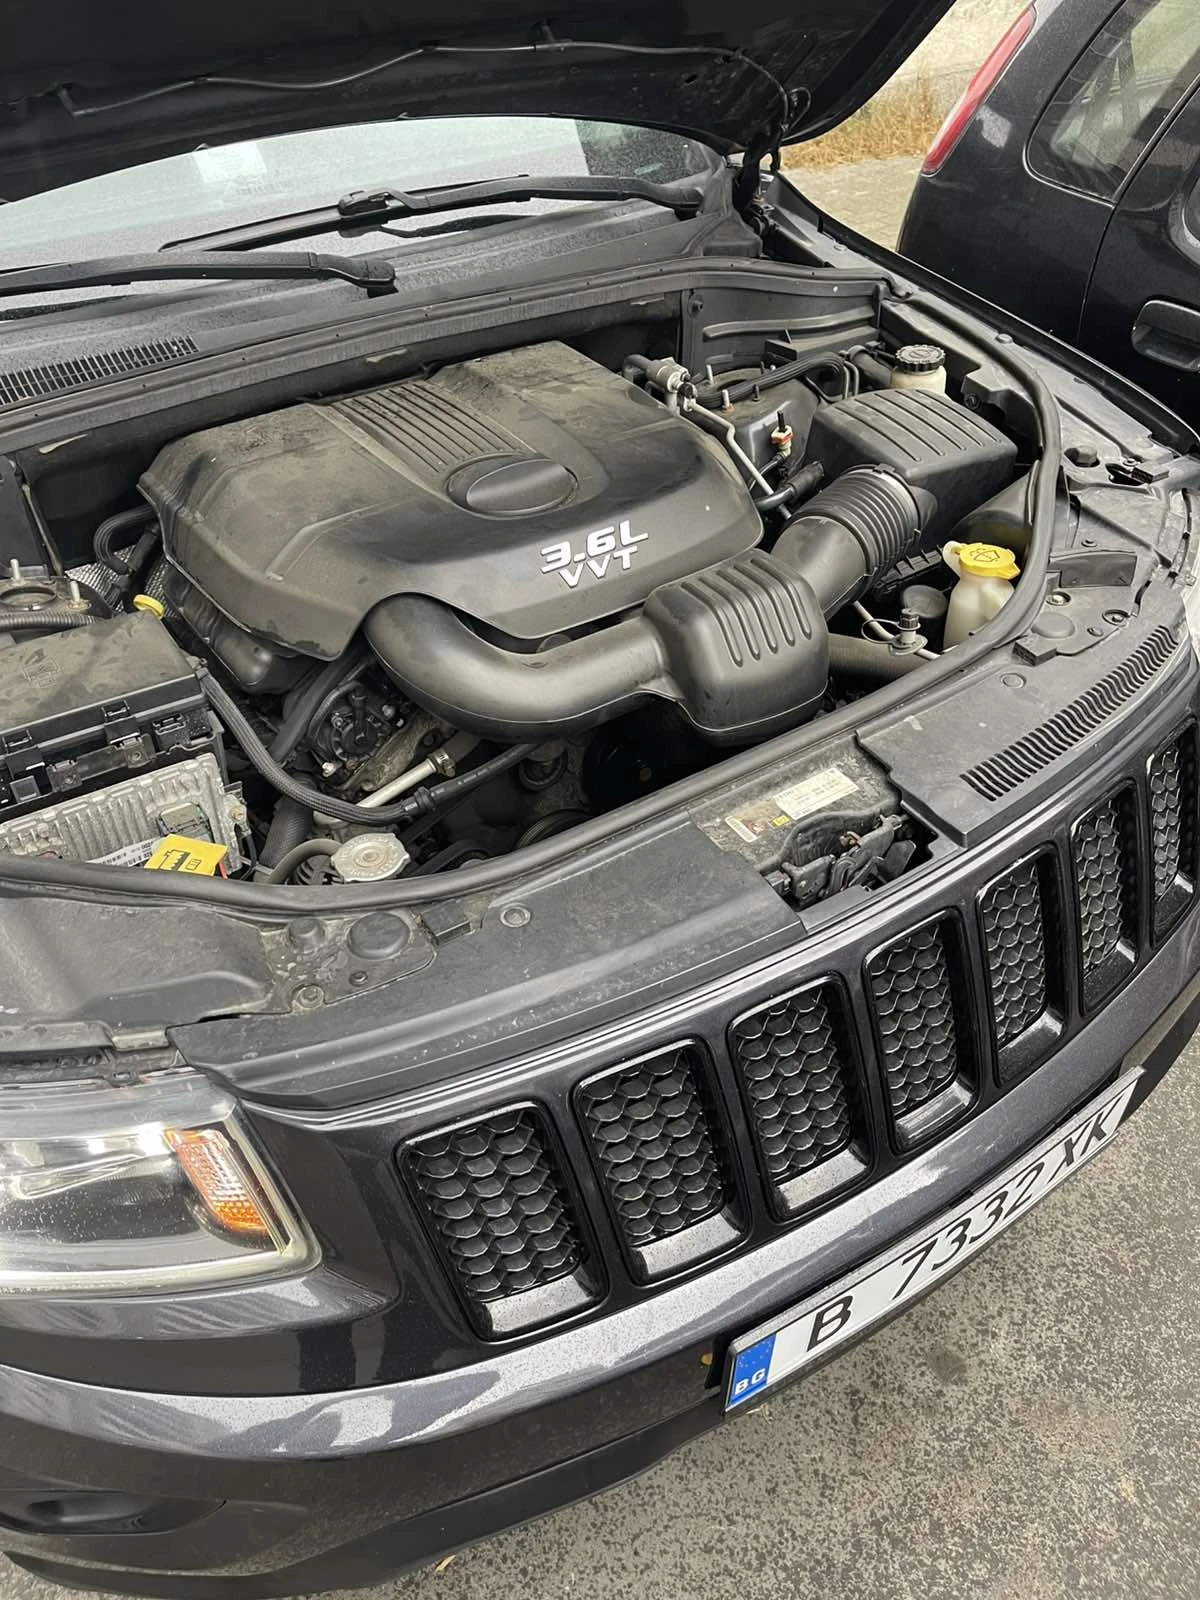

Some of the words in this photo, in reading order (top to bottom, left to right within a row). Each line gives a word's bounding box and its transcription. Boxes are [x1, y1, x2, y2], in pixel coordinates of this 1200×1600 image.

[540, 520, 648, 573] 3.6L
[560, 546, 638, 587] VVT
[807, 1295, 853, 1352] B
[892, 1162, 1045, 1300] 7332
[1047, 1092, 1125, 1184] XK
[735, 1368, 766, 1395] BG
